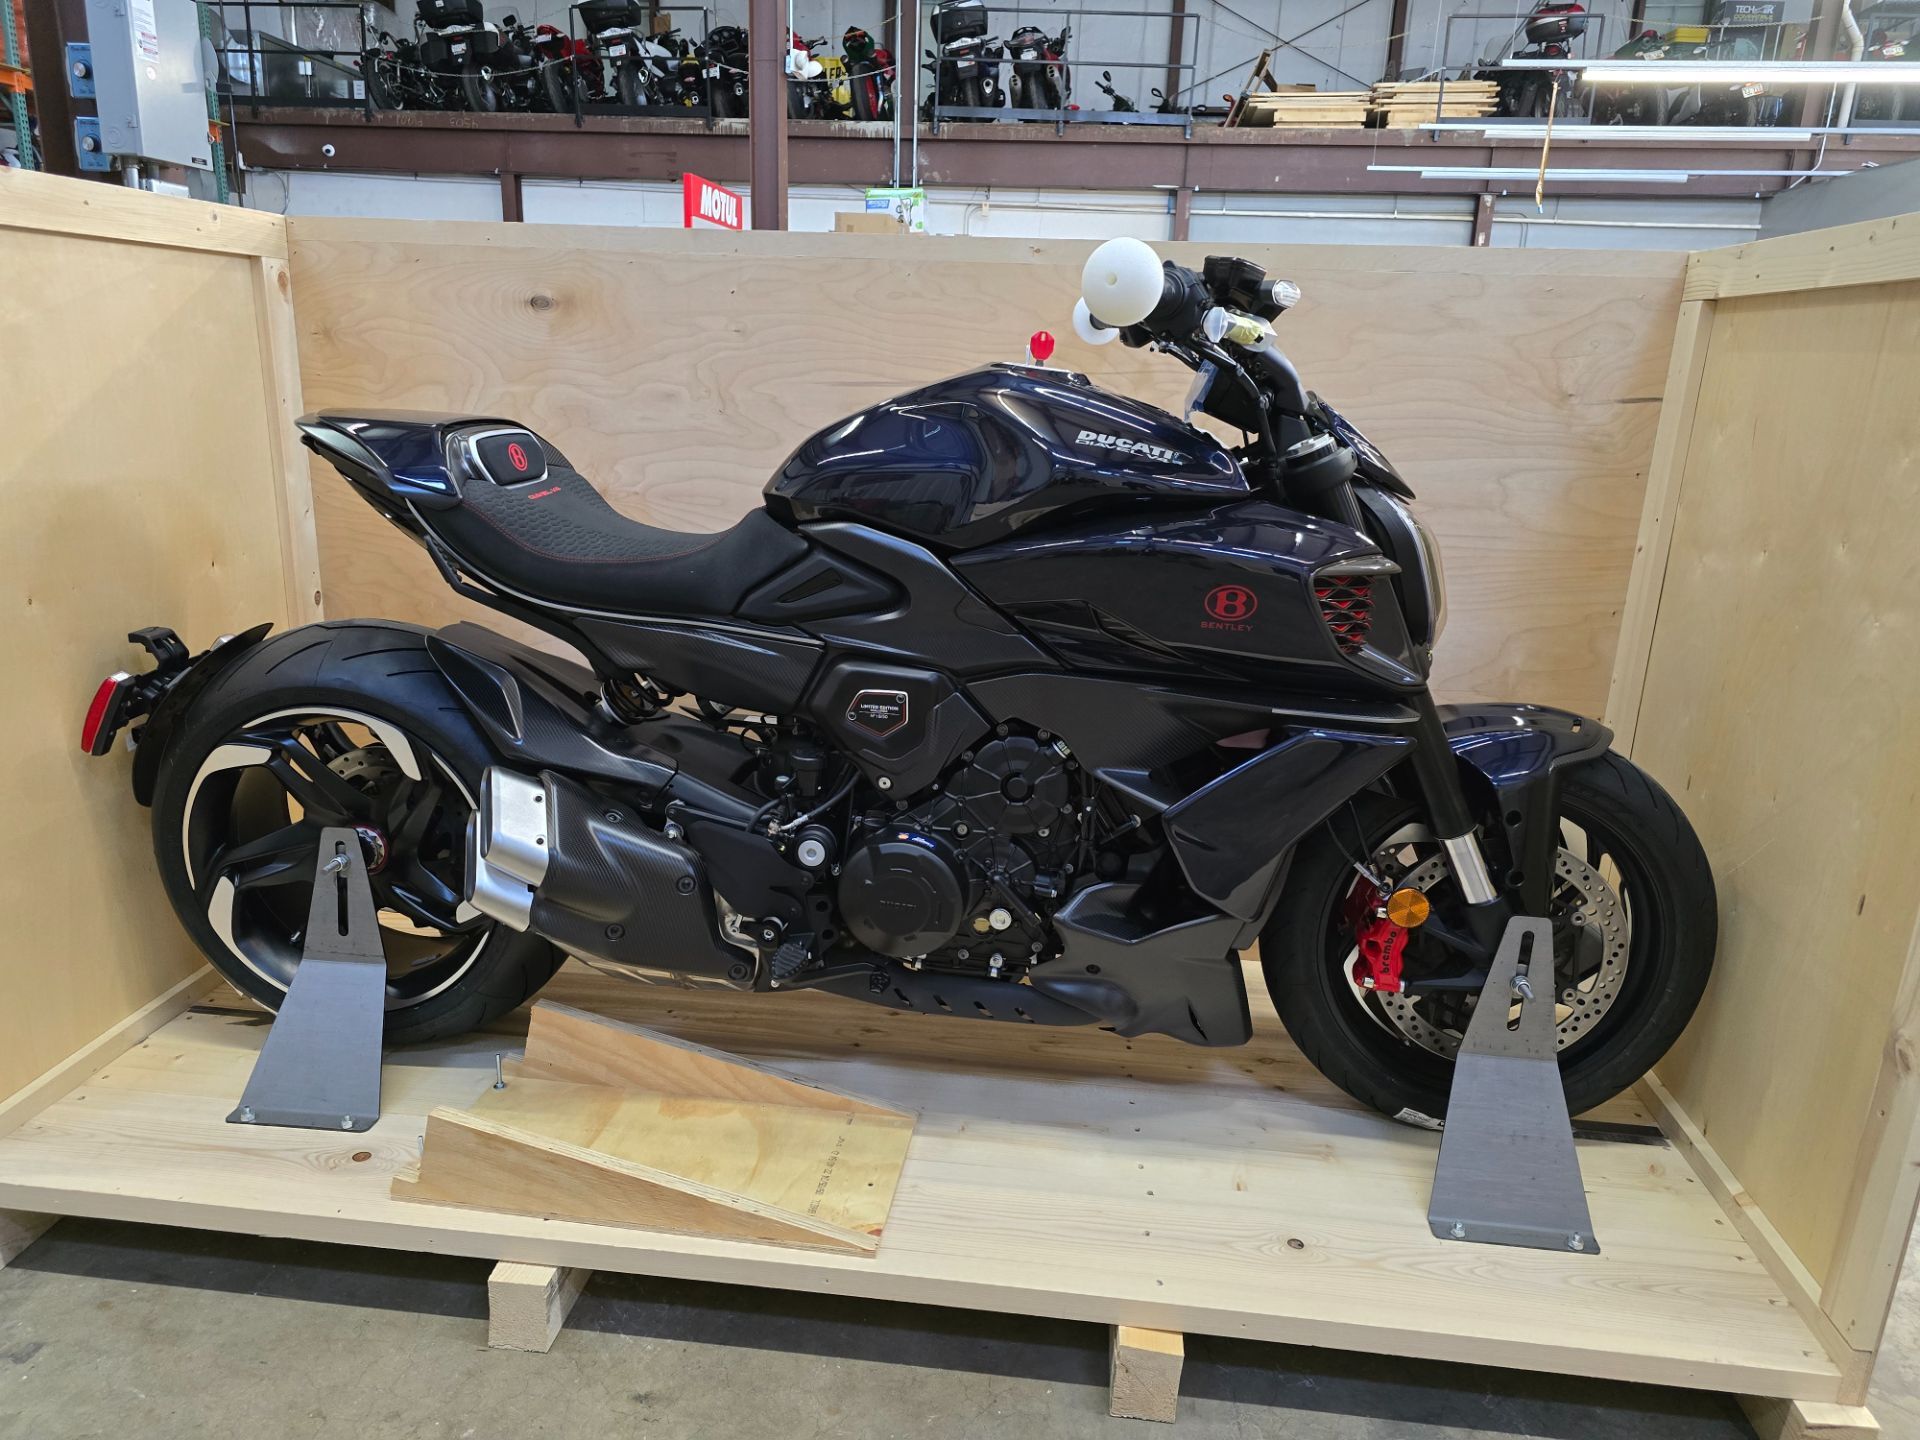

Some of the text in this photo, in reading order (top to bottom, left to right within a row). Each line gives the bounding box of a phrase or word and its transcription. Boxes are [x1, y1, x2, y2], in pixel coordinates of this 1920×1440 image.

[700, 183, 738, 228] MOTUL
[1076, 429, 1174, 460] DUCATI
[1215, 590, 1247, 617] B
[1200, 621, 1255, 632] BENTLEY
[1381, 931, 1397, 974] brembo
